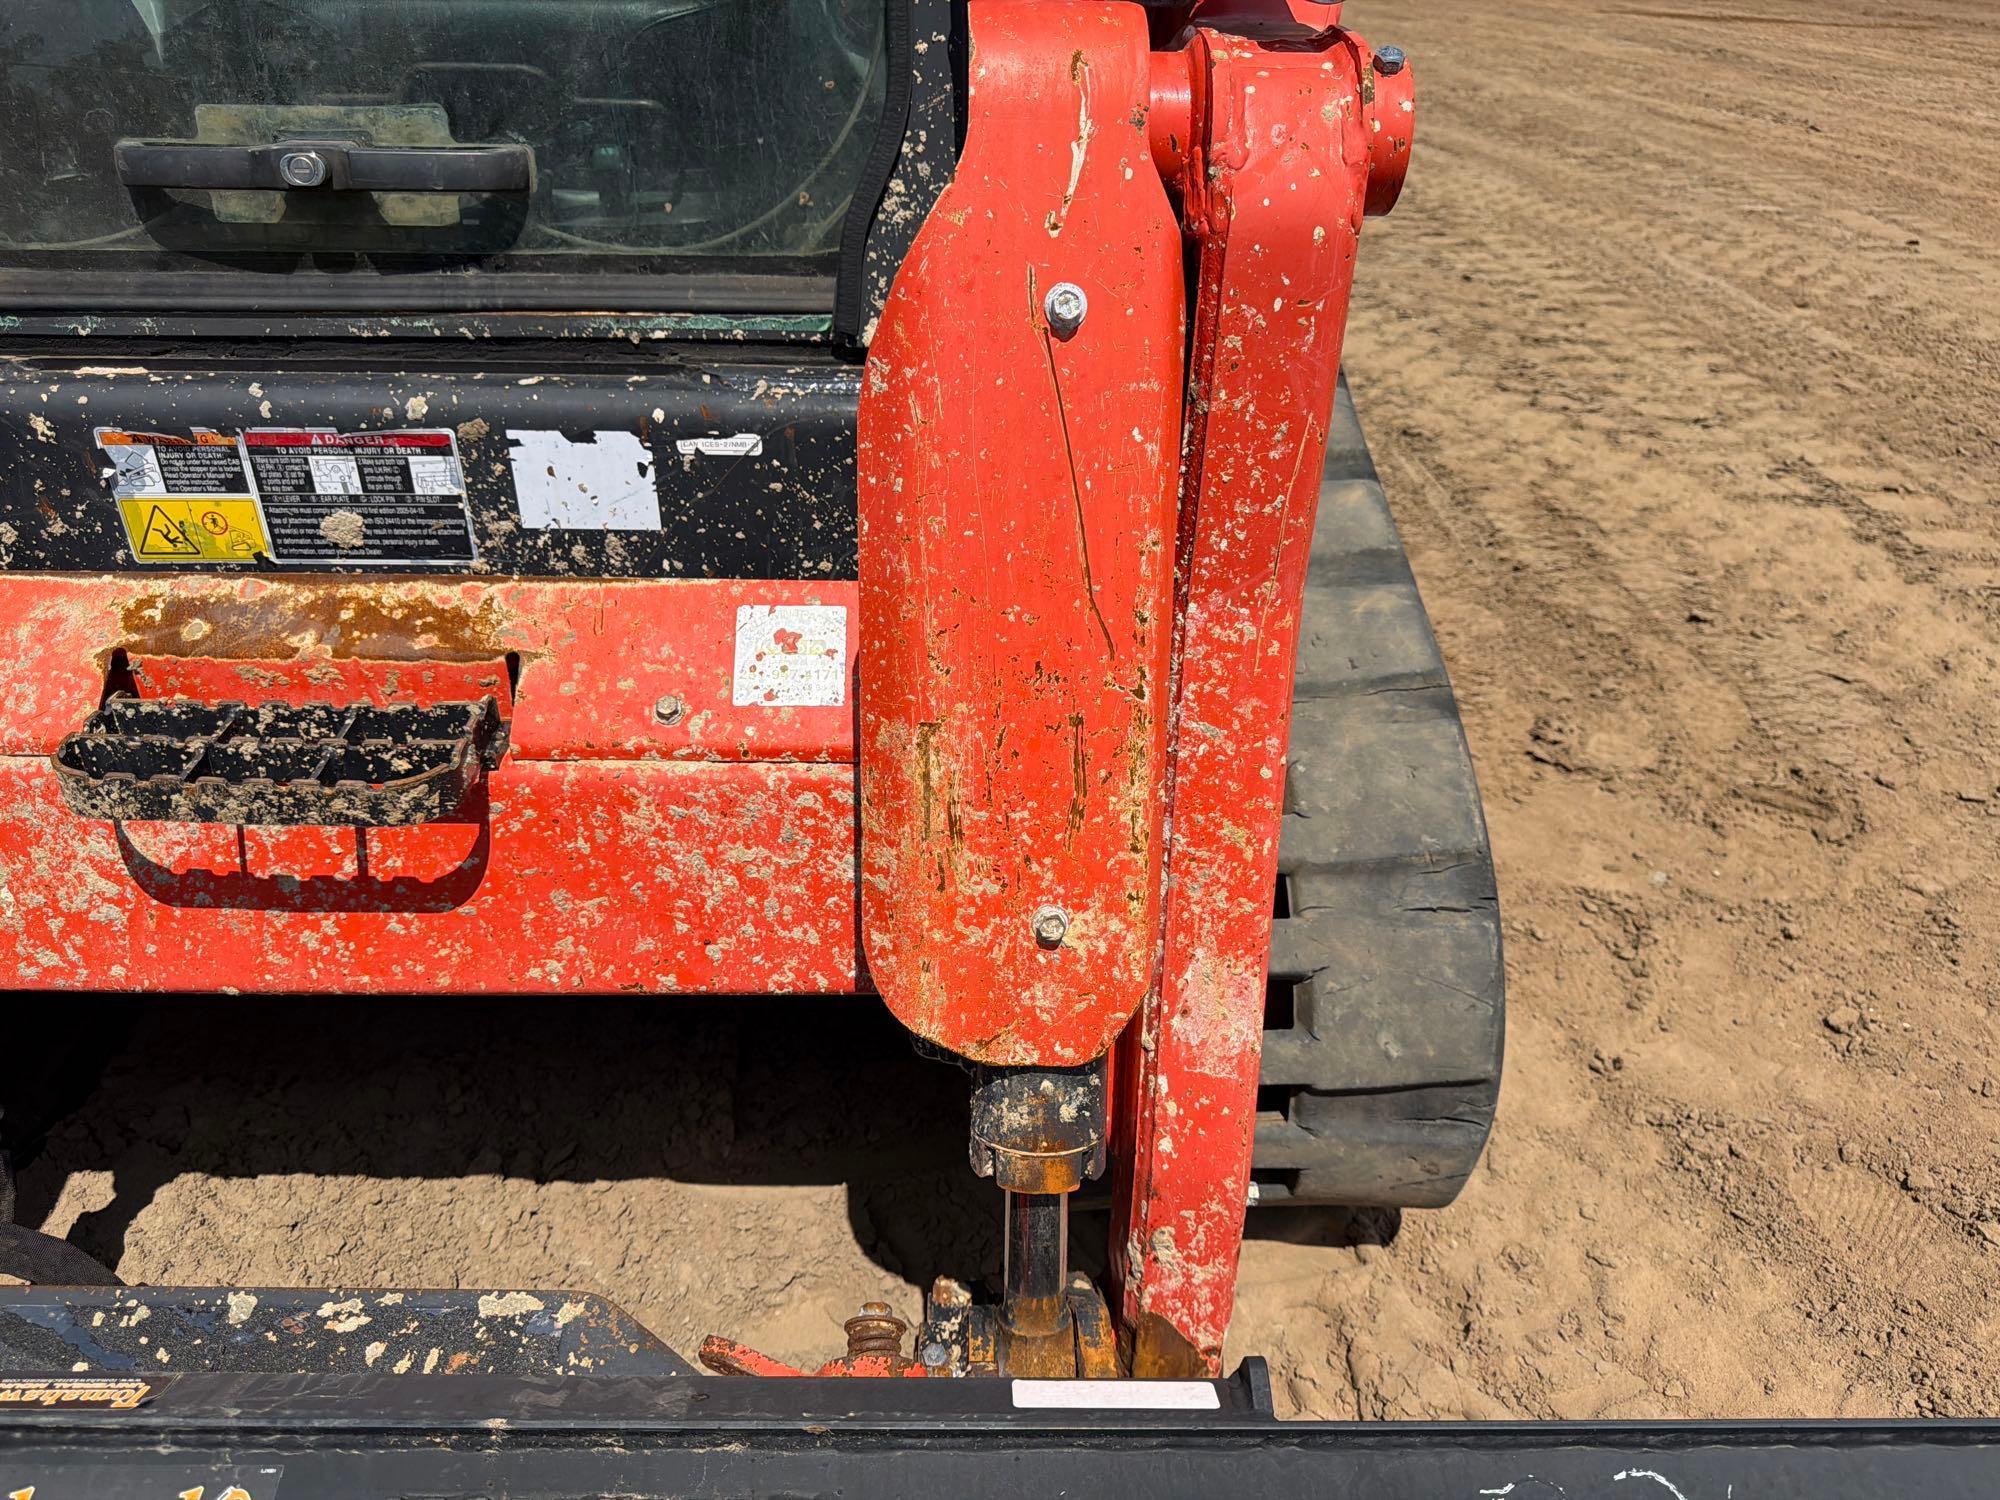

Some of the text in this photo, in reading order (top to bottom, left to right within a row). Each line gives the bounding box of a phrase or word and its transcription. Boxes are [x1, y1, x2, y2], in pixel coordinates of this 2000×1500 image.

[325, 434, 384, 446] DANGER
[276, 447, 287, 456] TO
[289, 447, 311, 456] AVOID
[313, 447, 353, 456] PERSONAL
[354, 447, 381, 456] INJURY
[383, 447, 394, 456] OR
